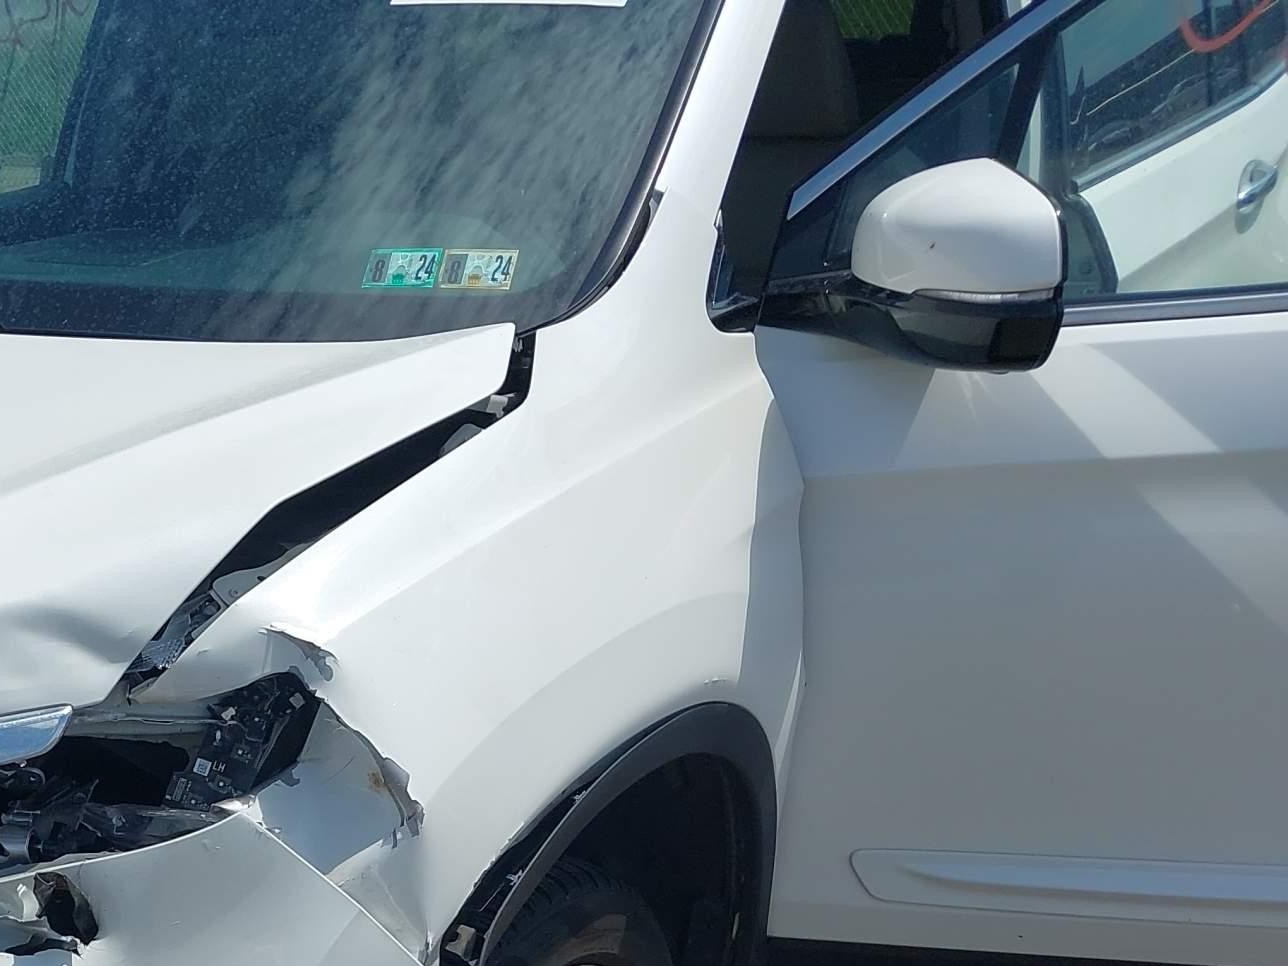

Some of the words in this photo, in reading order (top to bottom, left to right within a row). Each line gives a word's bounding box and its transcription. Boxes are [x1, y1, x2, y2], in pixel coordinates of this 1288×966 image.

[414, 254, 437, 281] 24
[490, 254, 513, 282] 24
[212, 760, 226, 773] LH
